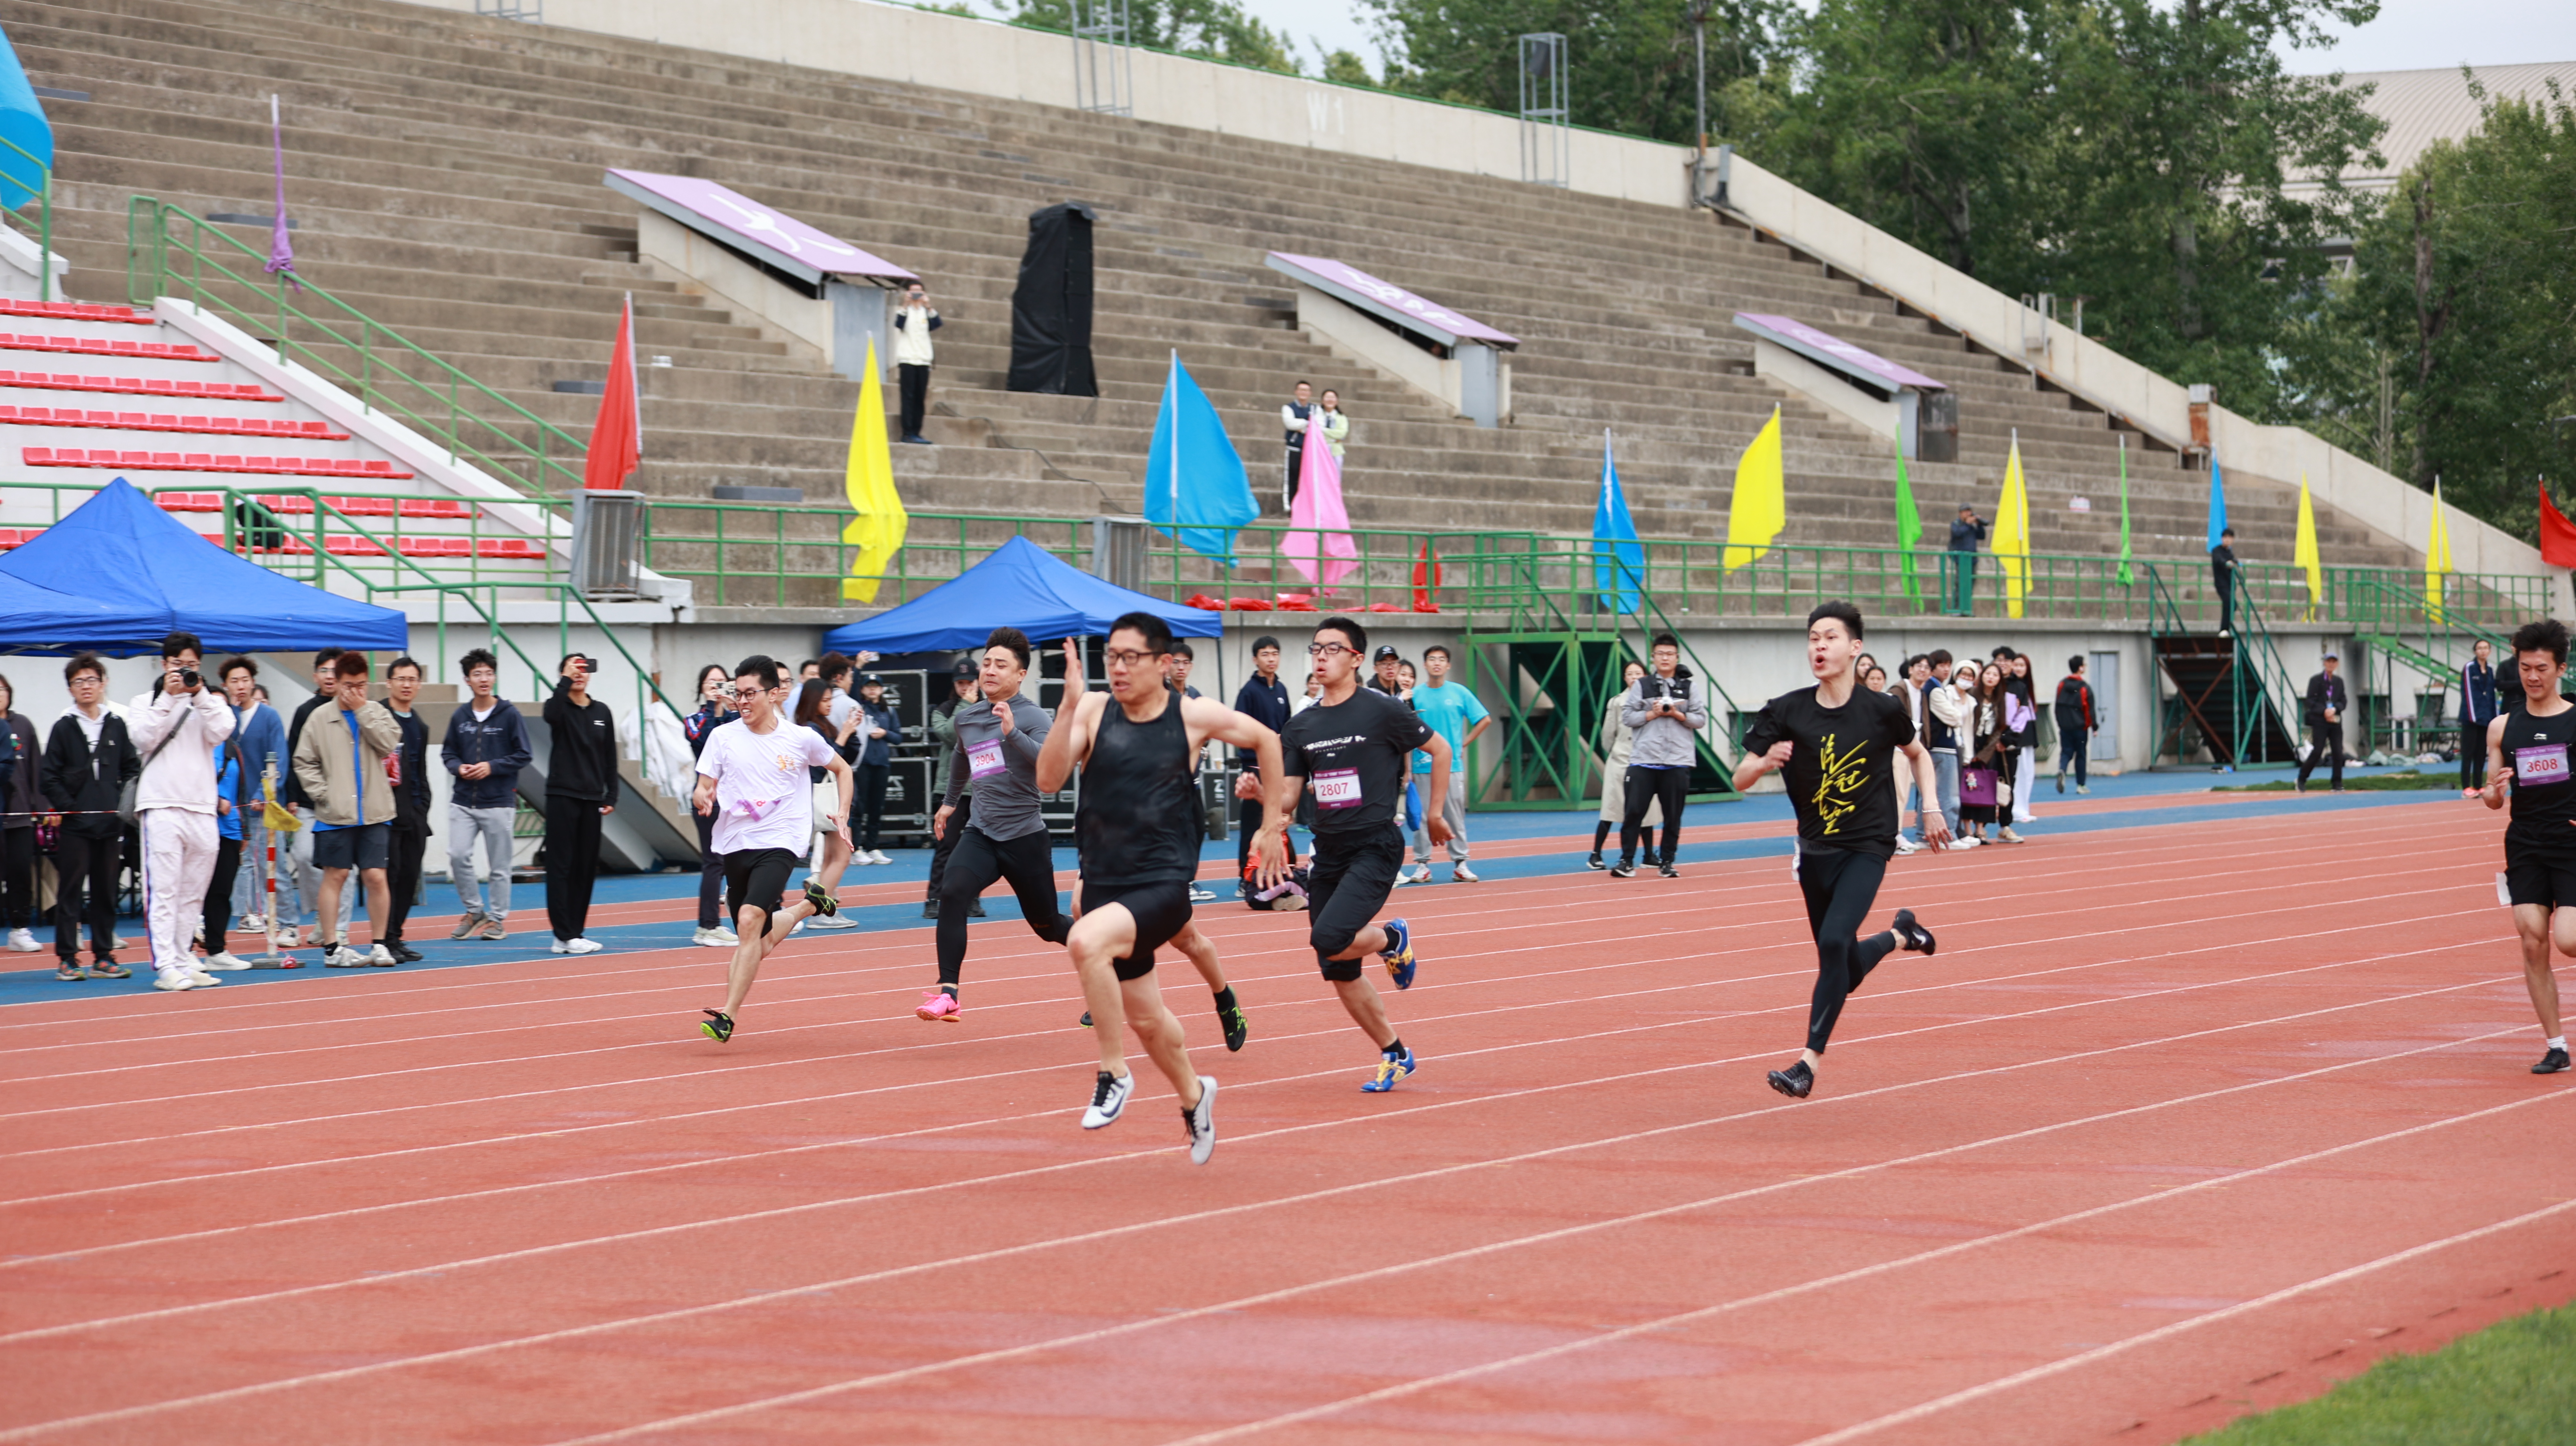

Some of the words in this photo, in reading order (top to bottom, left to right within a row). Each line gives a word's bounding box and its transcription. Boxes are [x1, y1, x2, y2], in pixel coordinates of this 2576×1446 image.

[1306, 91, 1345, 135] W1
[975, 752, 995, 767] 3904
[2527, 758, 2558, 772] 3608
[1320, 782, 1348, 796] 2807
